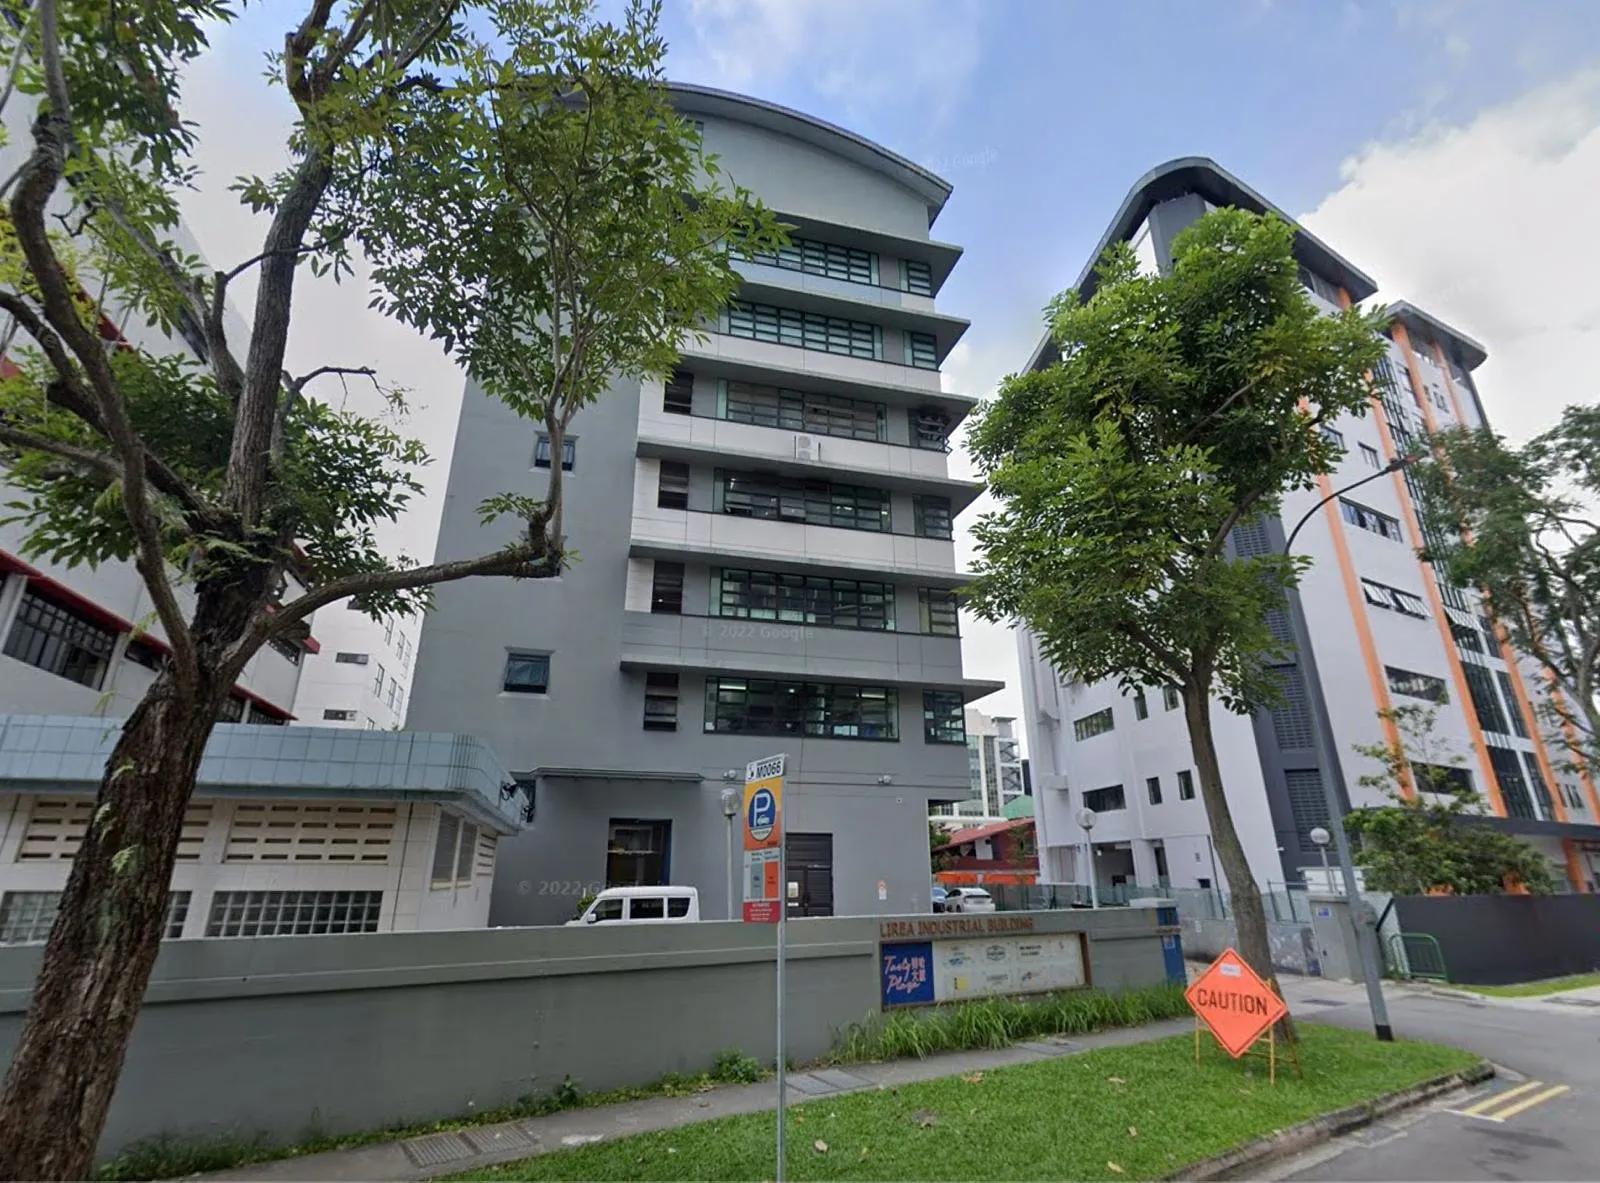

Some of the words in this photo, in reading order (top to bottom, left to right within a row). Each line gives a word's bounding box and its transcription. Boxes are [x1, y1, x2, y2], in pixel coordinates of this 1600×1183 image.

[753, 792, 771, 827] P
[918, 917, 985, 936] INDUSTRIAL
[988, 915, 1034, 933] BUILDING
[1196, 987, 1269, 1017] CAUTION
